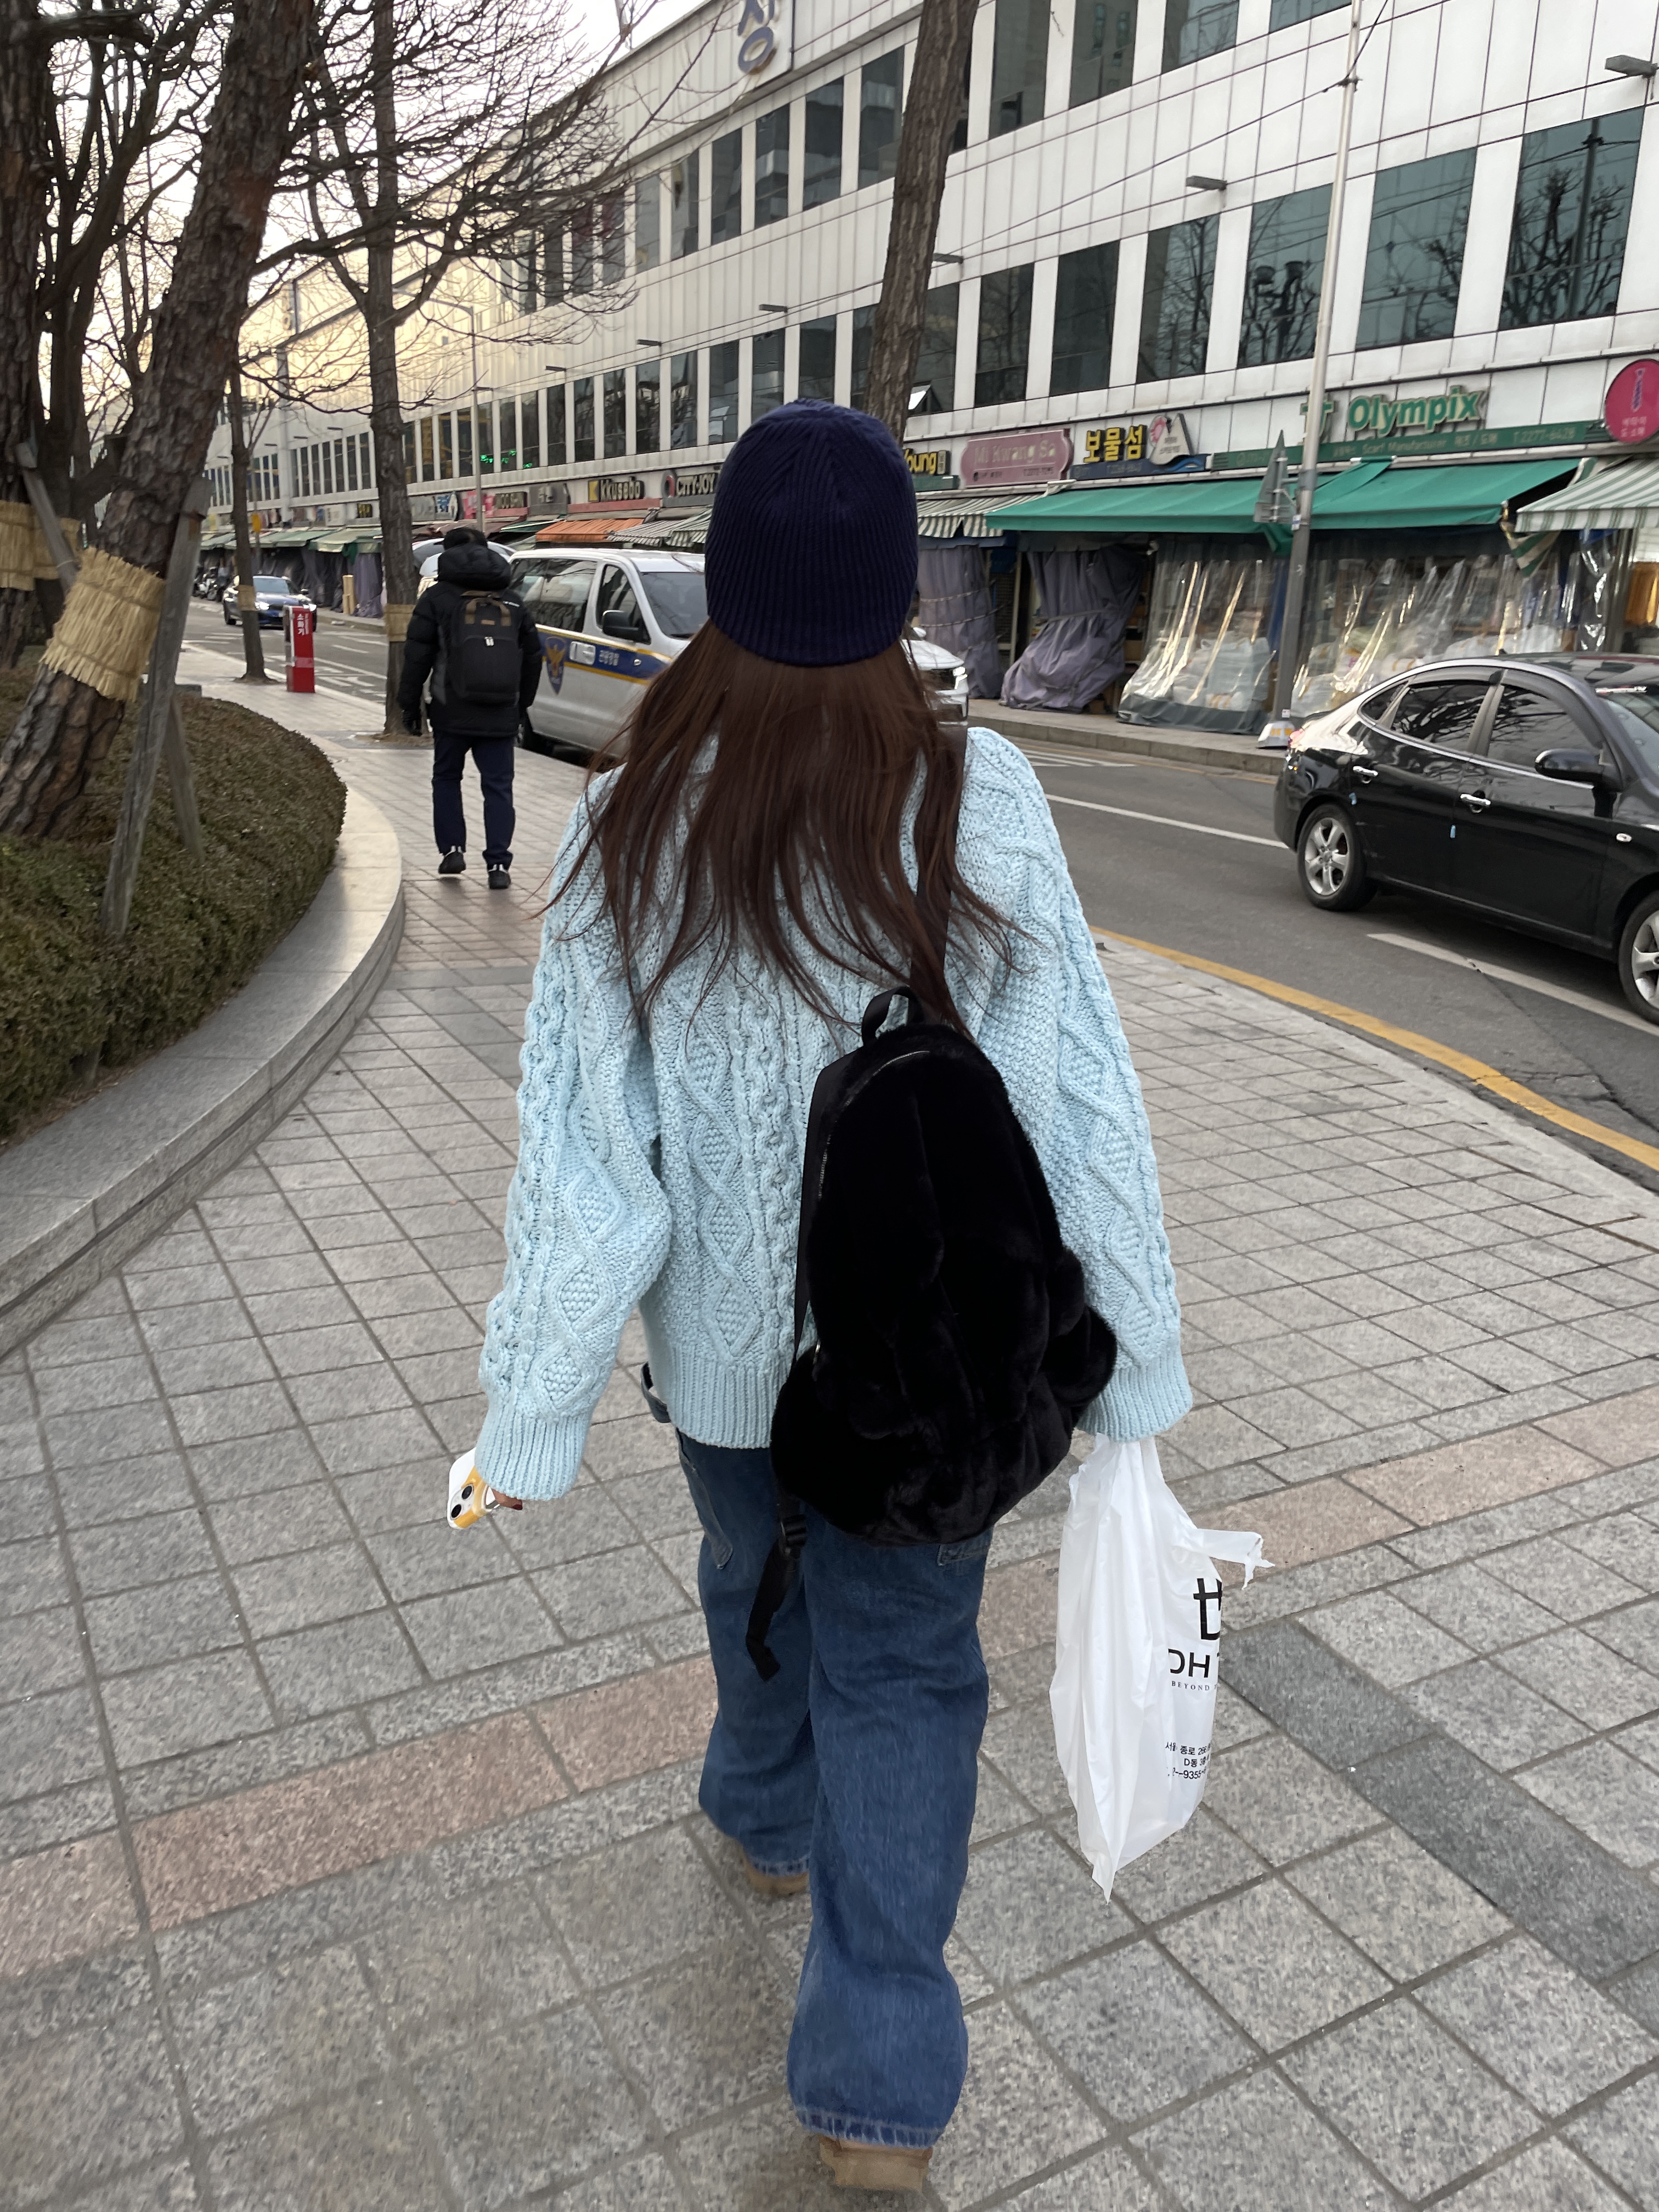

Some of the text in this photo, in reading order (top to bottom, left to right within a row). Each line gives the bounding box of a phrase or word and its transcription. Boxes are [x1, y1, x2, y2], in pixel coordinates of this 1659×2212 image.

[1348, 385, 1481, 437] Olympix
[1083, 425, 1144, 463] 보물섬
[1171, 1680, 1210, 1691] BEYOND
[1180, 1745, 1196, 1756] 종로
